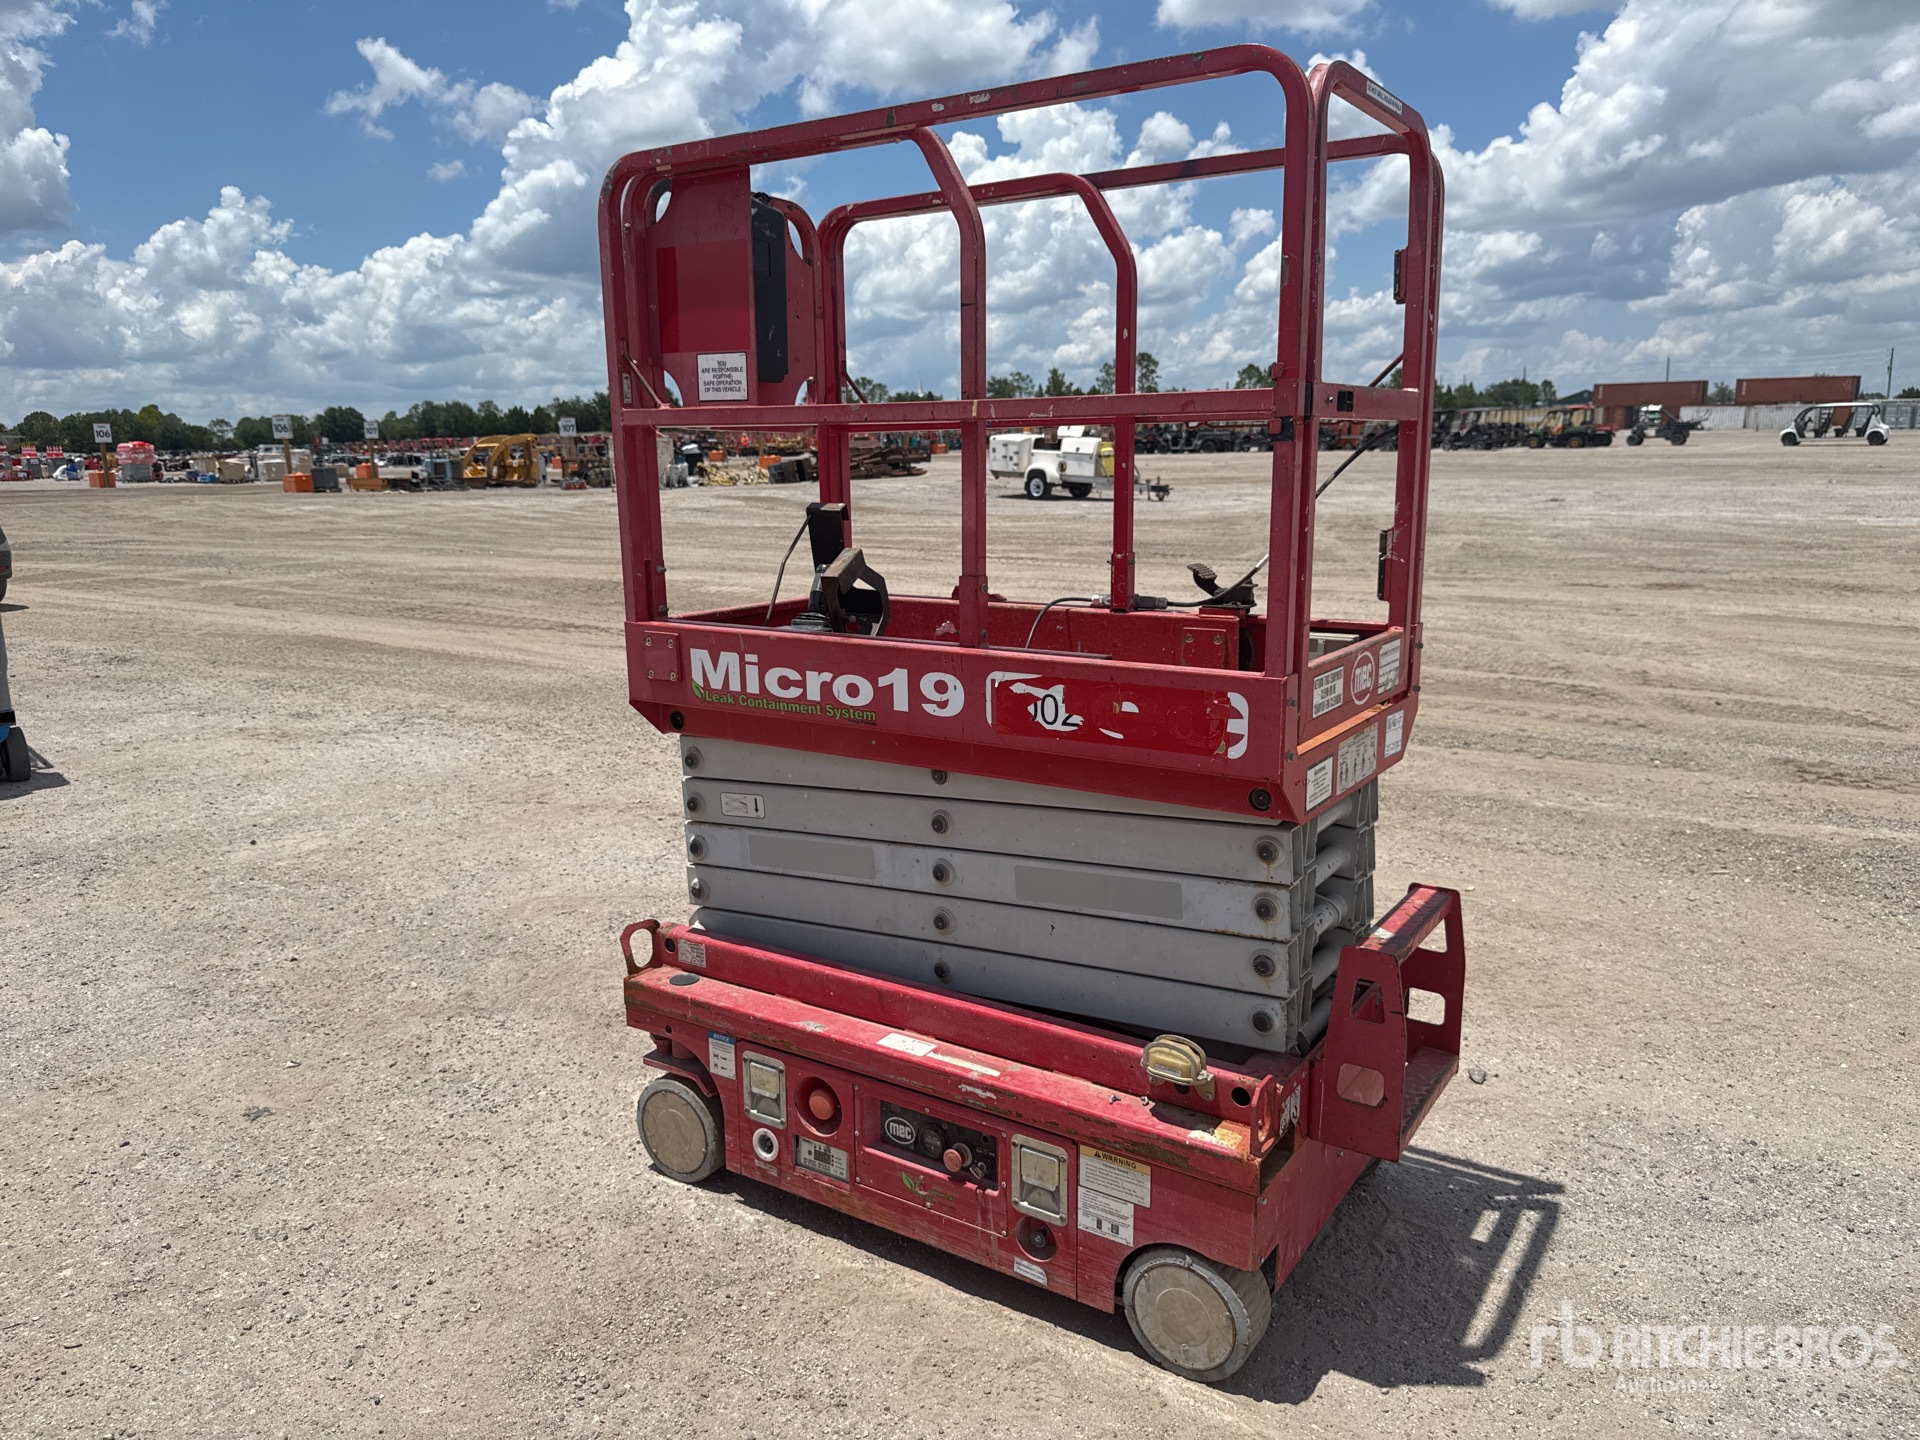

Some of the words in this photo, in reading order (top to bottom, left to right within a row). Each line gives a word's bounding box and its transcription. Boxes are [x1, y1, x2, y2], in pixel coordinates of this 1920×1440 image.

[274, 424, 288, 432] 106
[690, 648, 965, 717] Micro19
[705, 690, 735, 705] Leak
[738, 694, 822, 716] Containment
[826, 704, 876, 721] System
[713, 1033, 729, 1042] NOTICE
[1102, 1153, 1136, 1169] WARNING
